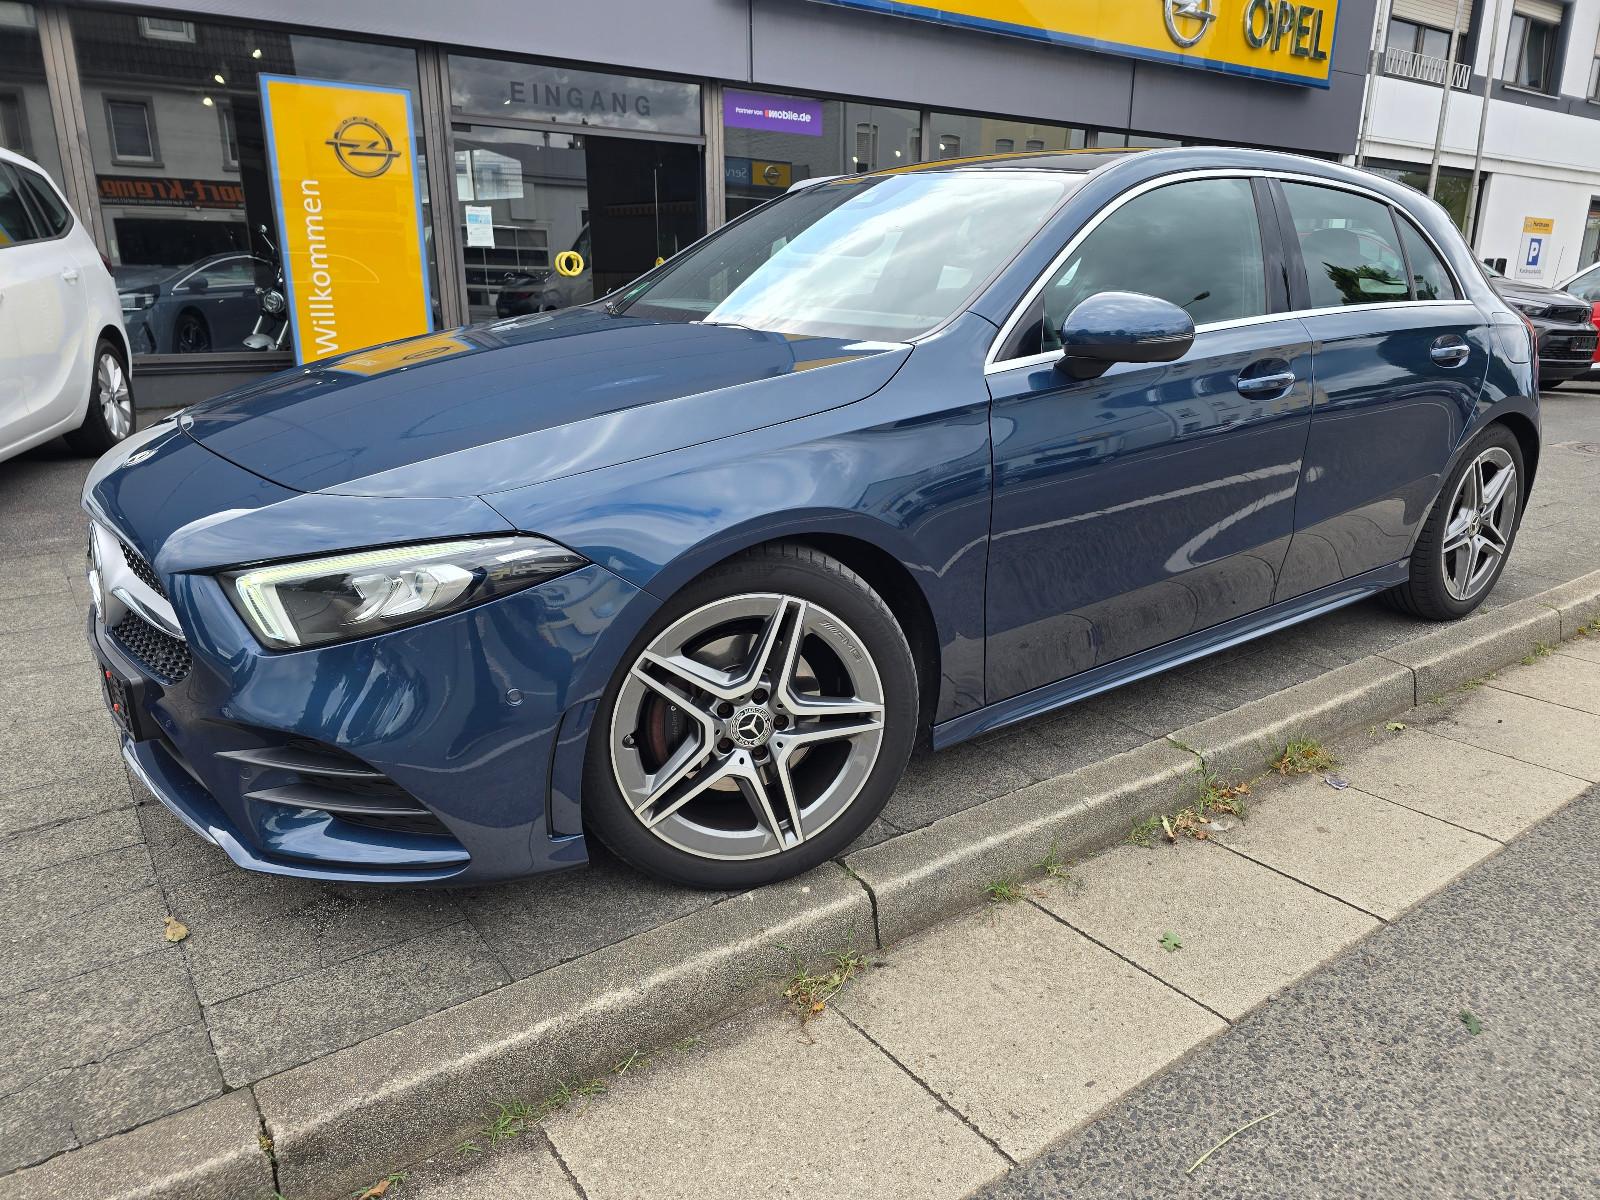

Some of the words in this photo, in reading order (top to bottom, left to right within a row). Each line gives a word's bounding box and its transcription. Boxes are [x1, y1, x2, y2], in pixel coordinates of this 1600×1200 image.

[1244, 0, 1327, 60] OPEL
[510, 81, 650, 116] EINGANG
[767, 109, 812, 122] mobile.de
[300, 178, 339, 356] Willkommen
